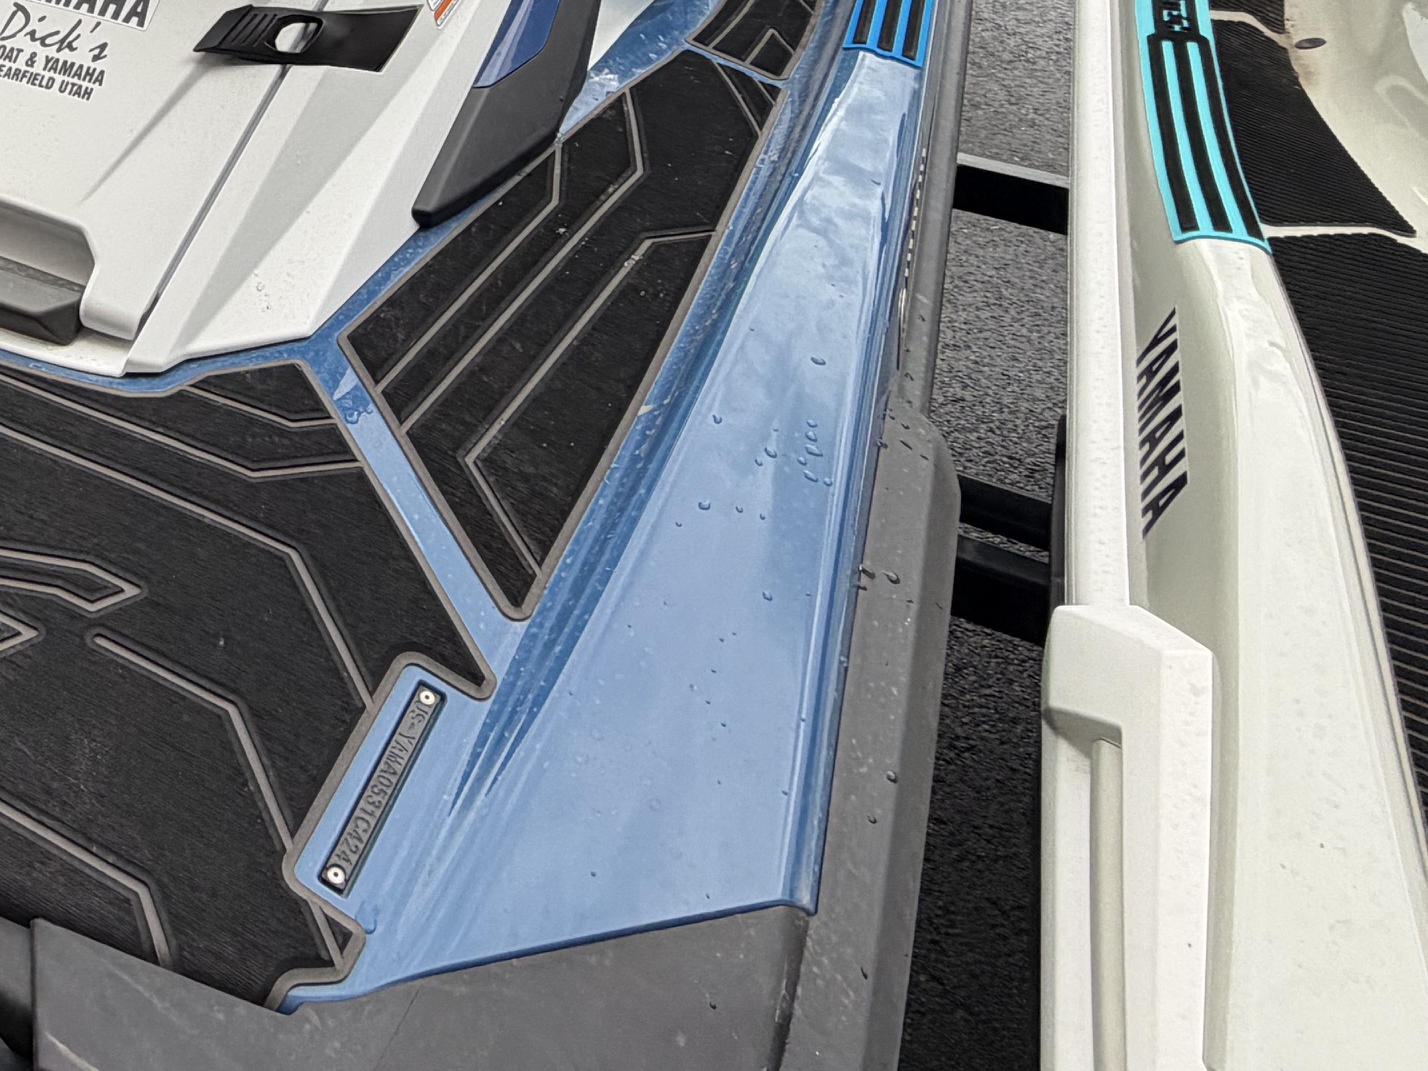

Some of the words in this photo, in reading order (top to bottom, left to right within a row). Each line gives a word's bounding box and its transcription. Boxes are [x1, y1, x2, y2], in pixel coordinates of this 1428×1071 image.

[0, 1, 109, 63] Dick's
[25, 51, 38, 69] &
[42, 54, 106, 87] YAMAHA
[58, 79, 95, 102] UTAH
[1136, 306, 1189, 541] YAMAHA
